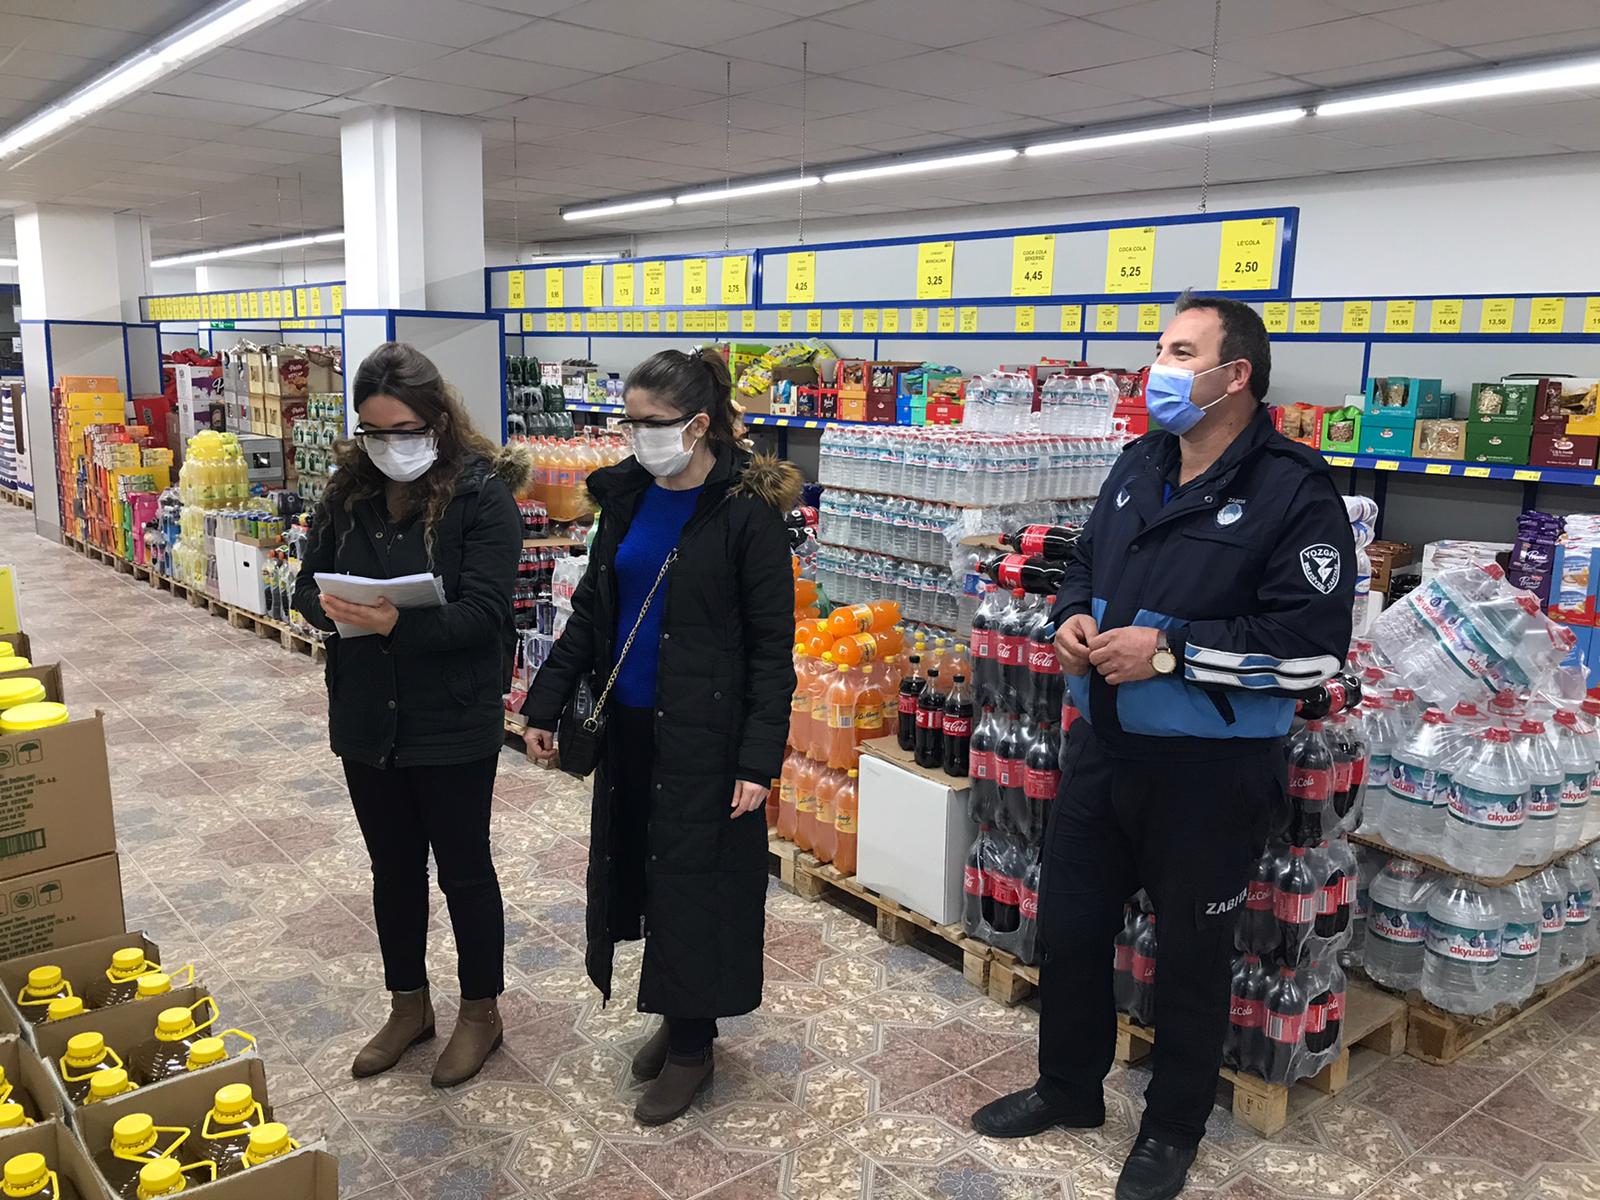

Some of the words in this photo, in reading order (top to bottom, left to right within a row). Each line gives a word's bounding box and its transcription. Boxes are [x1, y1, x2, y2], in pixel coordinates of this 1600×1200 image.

[1236, 239, 1261, 247] LE'COLA
[1120, 266, 1141, 278] 5,25
[1234, 261, 1259, 274] 2,50
[926, 275, 943, 287] 3,25
[1024, 270, 1043, 282] 4,45
[794, 281, 808, 292] 4,25
[1205, 887, 1248, 915] ZABITA
